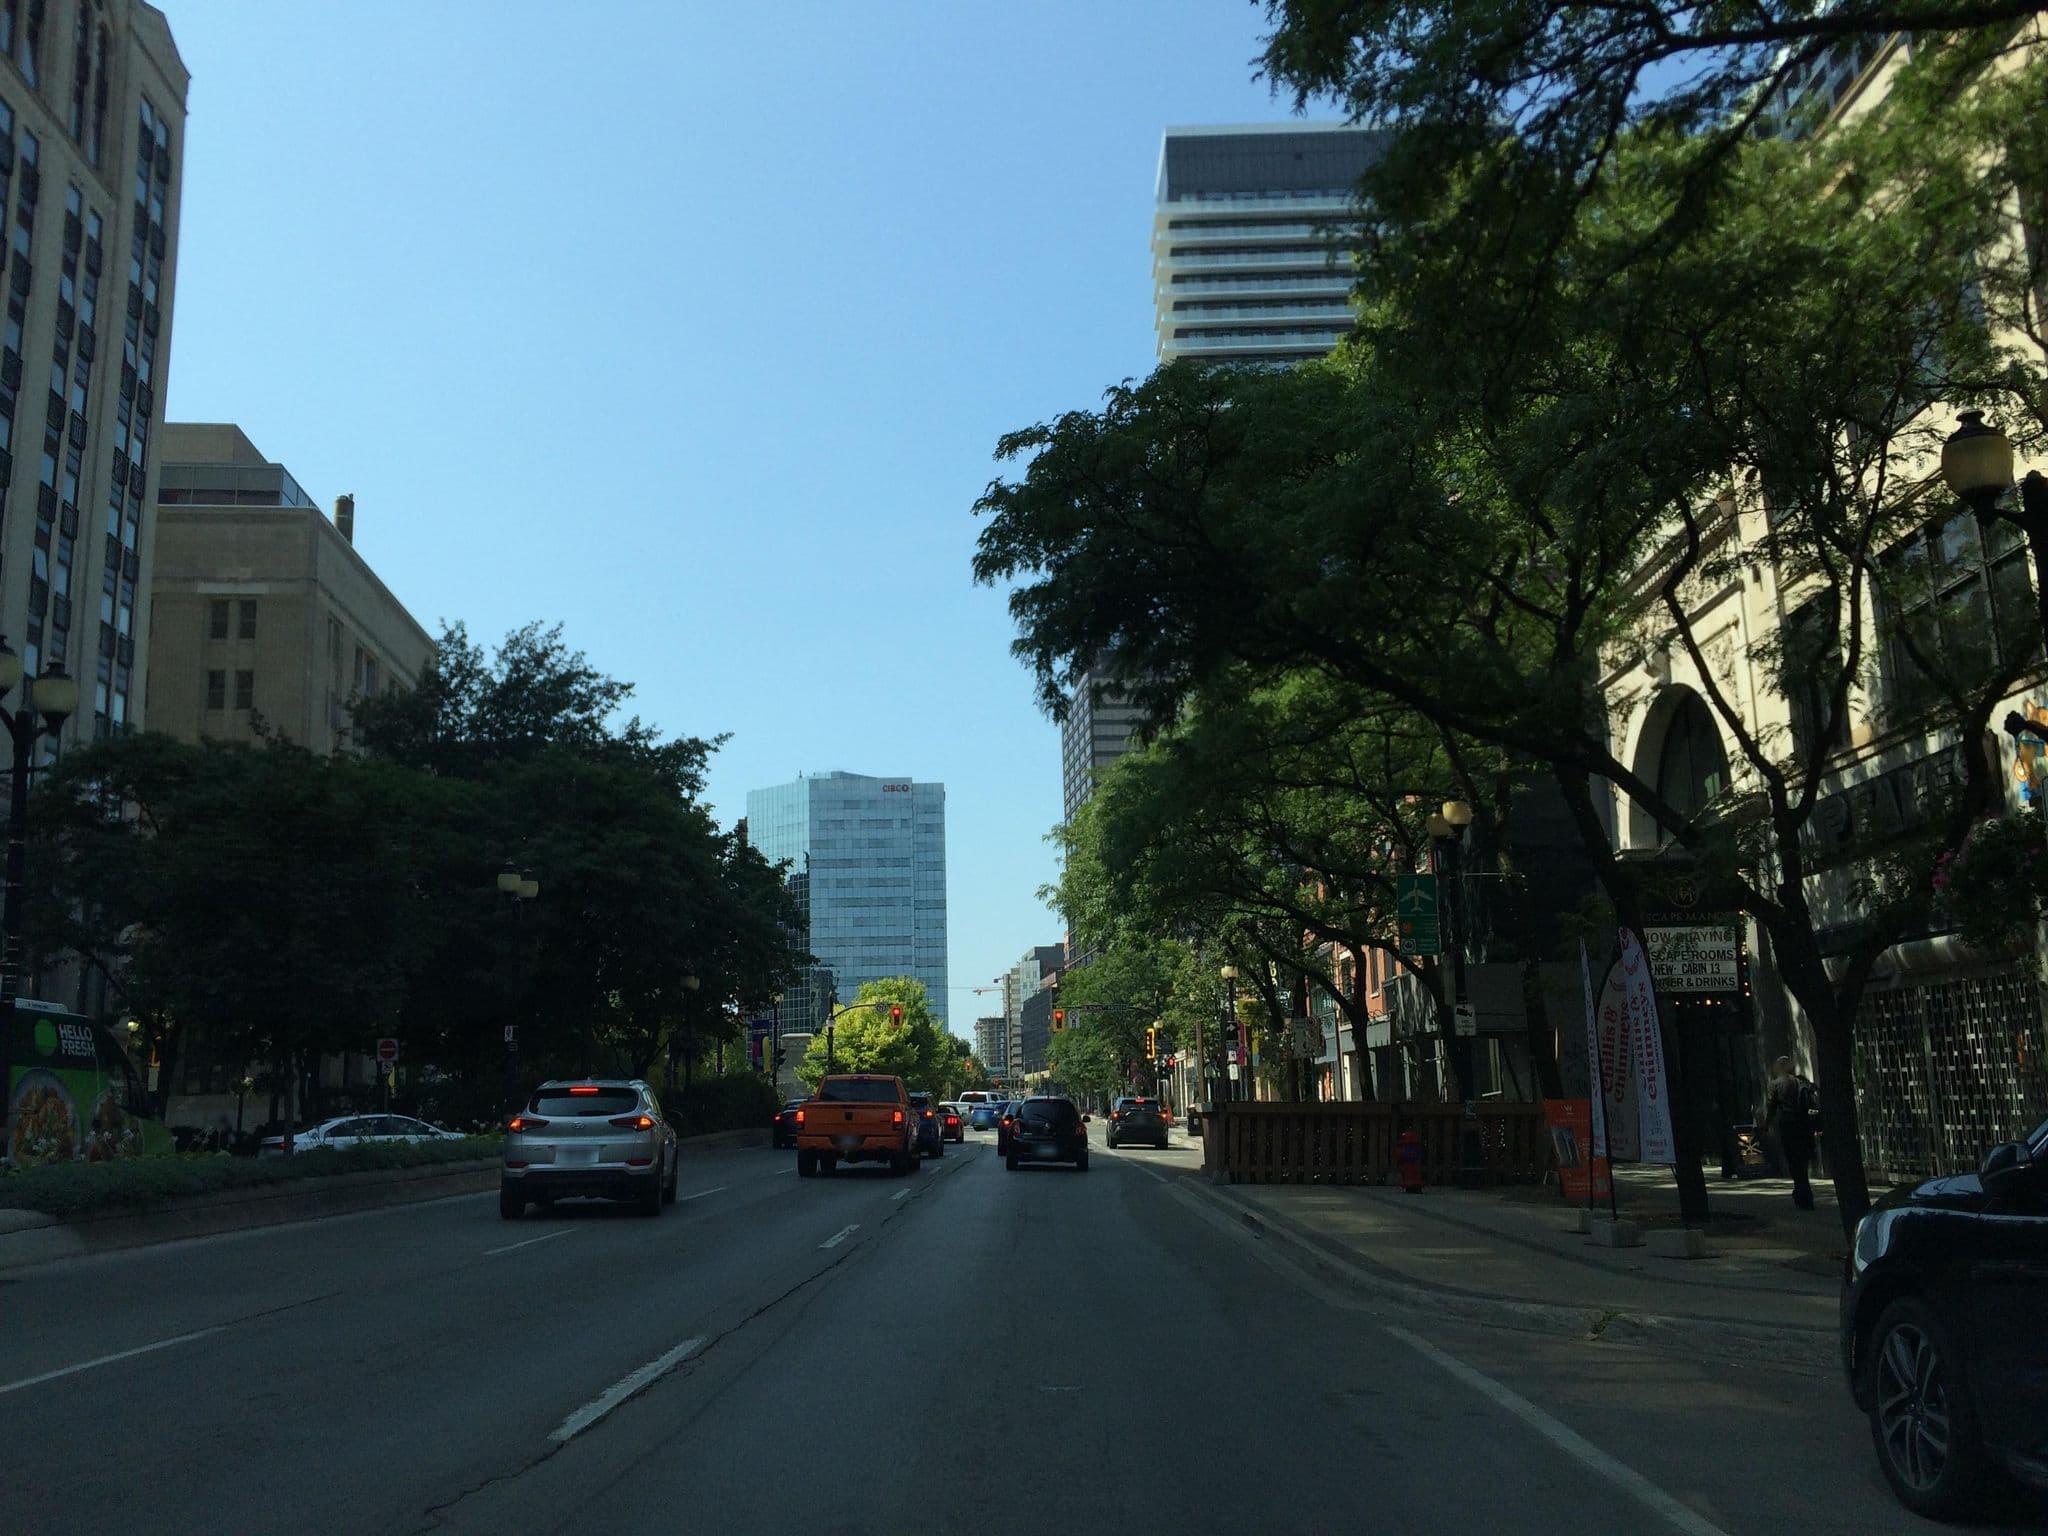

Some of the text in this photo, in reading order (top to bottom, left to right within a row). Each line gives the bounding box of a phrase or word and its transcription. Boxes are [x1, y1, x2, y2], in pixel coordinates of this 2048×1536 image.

[1650, 949, 1734, 962] SCAPE ROOMS
[1681, 963, 1707, 975] CABIN
[1711, 962, 1721, 974] 13
[1686, 977, 1694, 987] &
[1696, 977, 1736, 987] DRINKS
[58, 1023, 93, 1042] HELLO
[61, 1040, 97, 1057] FRESH
